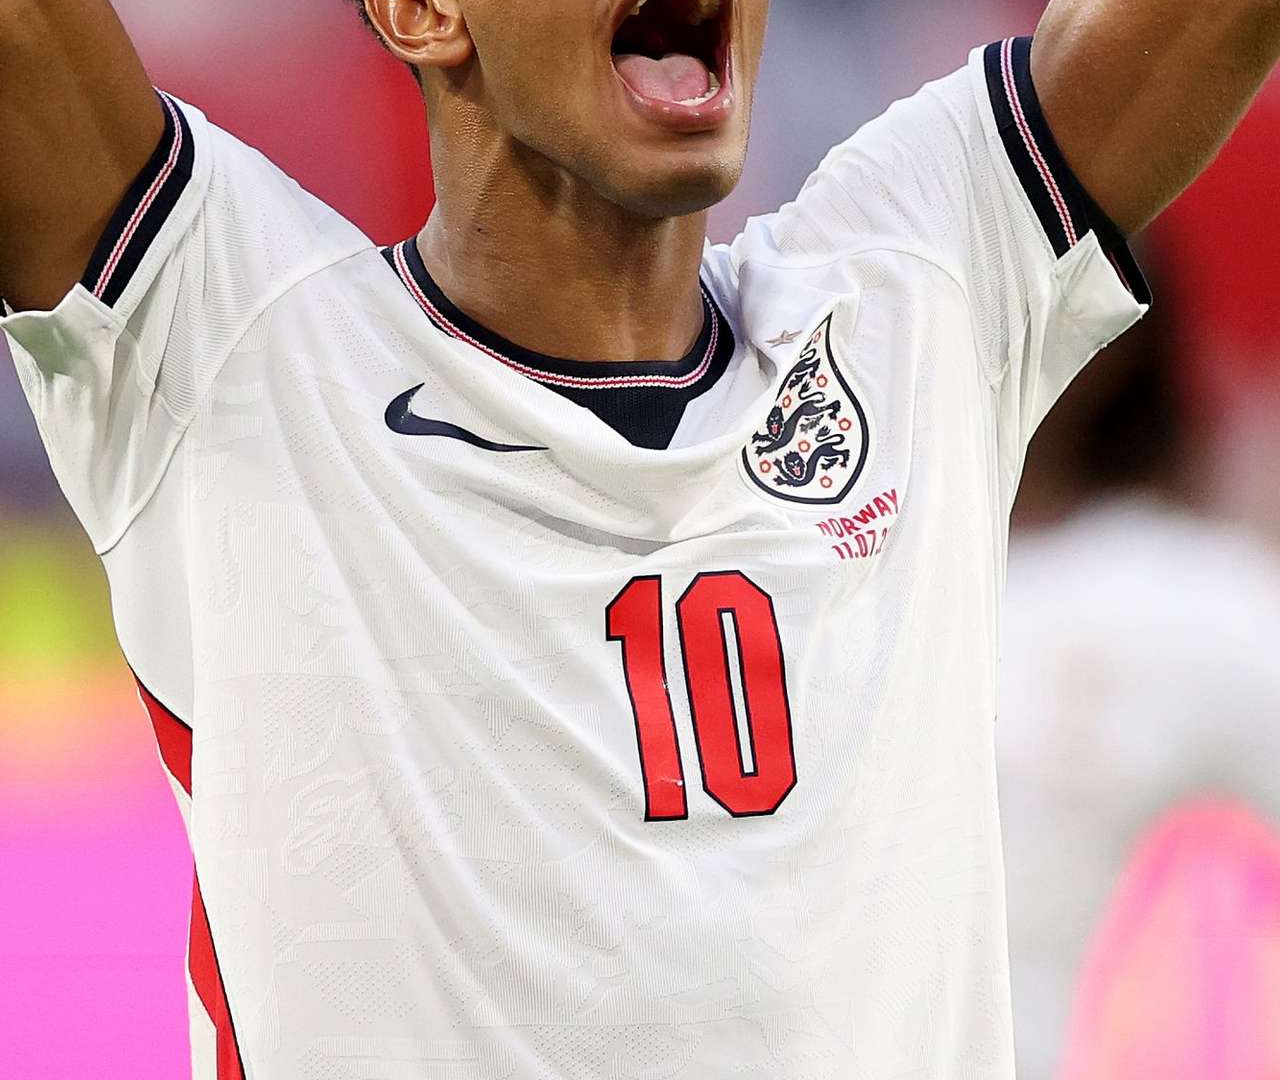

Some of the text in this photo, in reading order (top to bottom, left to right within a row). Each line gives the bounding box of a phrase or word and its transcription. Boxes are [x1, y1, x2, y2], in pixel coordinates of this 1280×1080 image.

[815, 488, 899, 538] NORWAY
[832, 527, 888, 560] 11.07.2
[605, 570, 797, 822] 10
